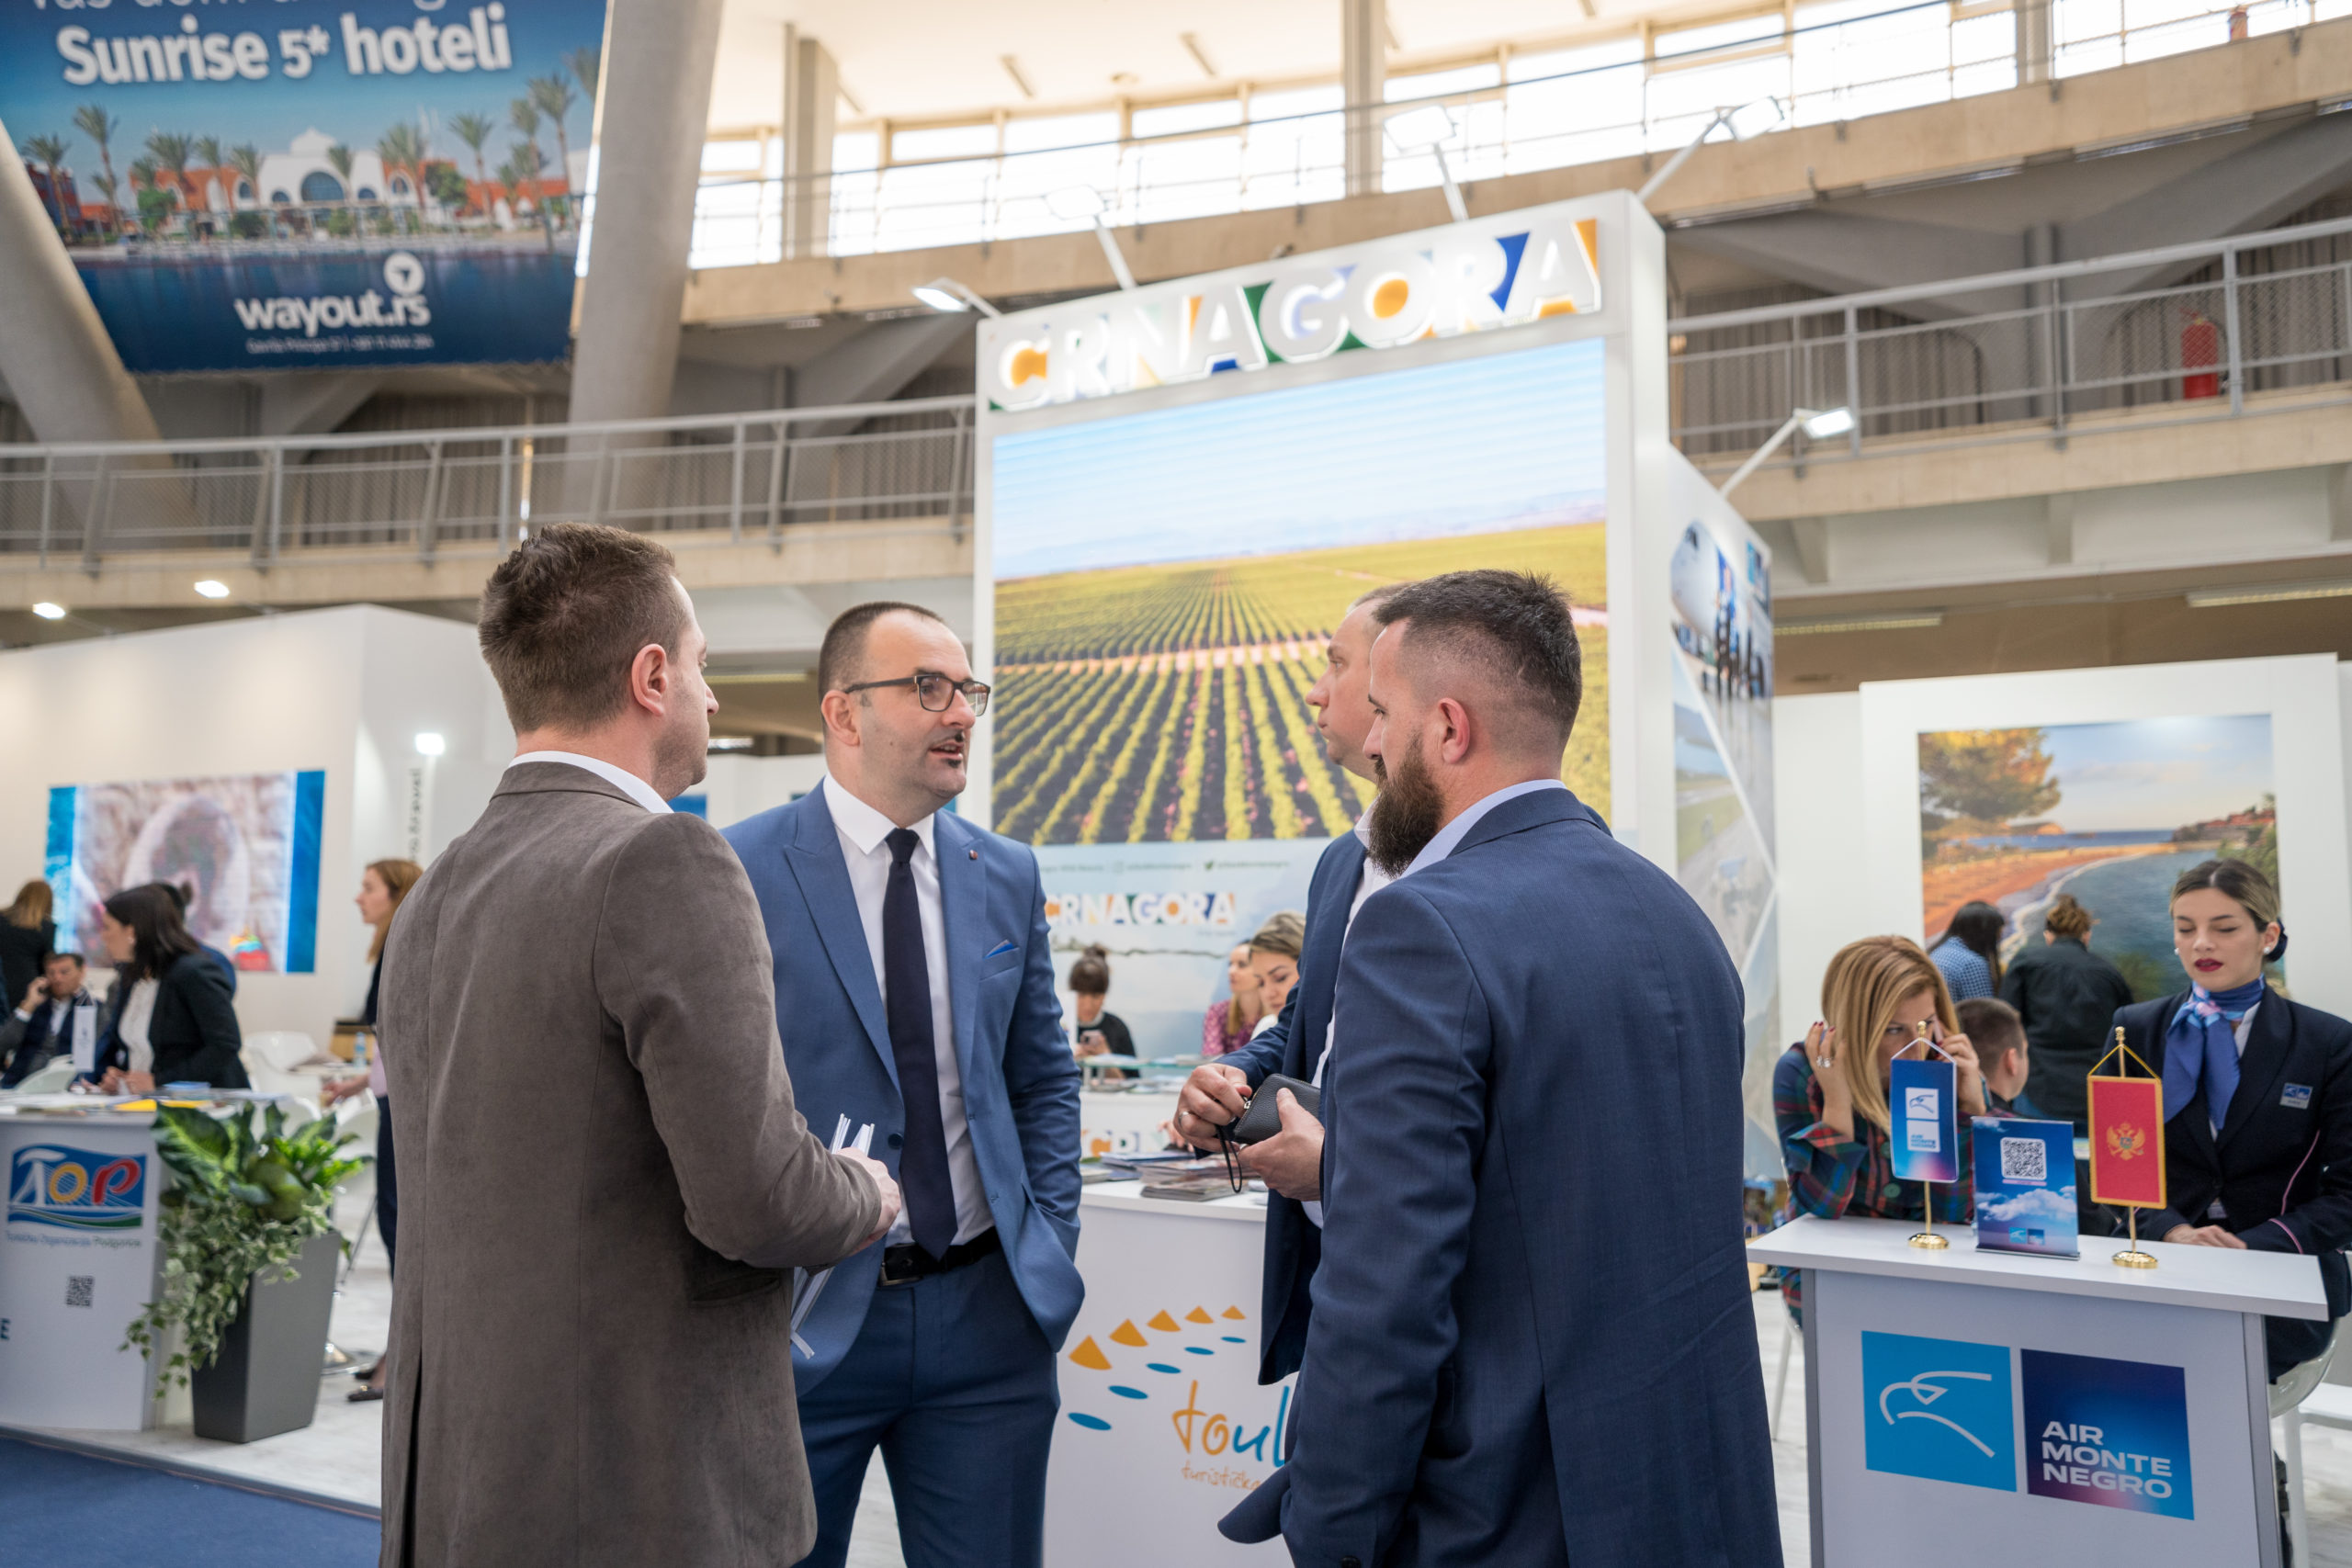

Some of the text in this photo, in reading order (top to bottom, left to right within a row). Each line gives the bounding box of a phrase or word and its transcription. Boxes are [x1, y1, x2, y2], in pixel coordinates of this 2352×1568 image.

[57, 14, 270, 85] Sunrise
[340, 2, 514, 75] hoteli
[233, 289, 432, 338] wayout.rs
[1171, 1379, 1291, 1468] toul
[2041, 1421, 2104, 1446] AIR
[2041, 1441, 2173, 1477] MONTE
[2042, 1464, 2173, 1499] NEGRO
